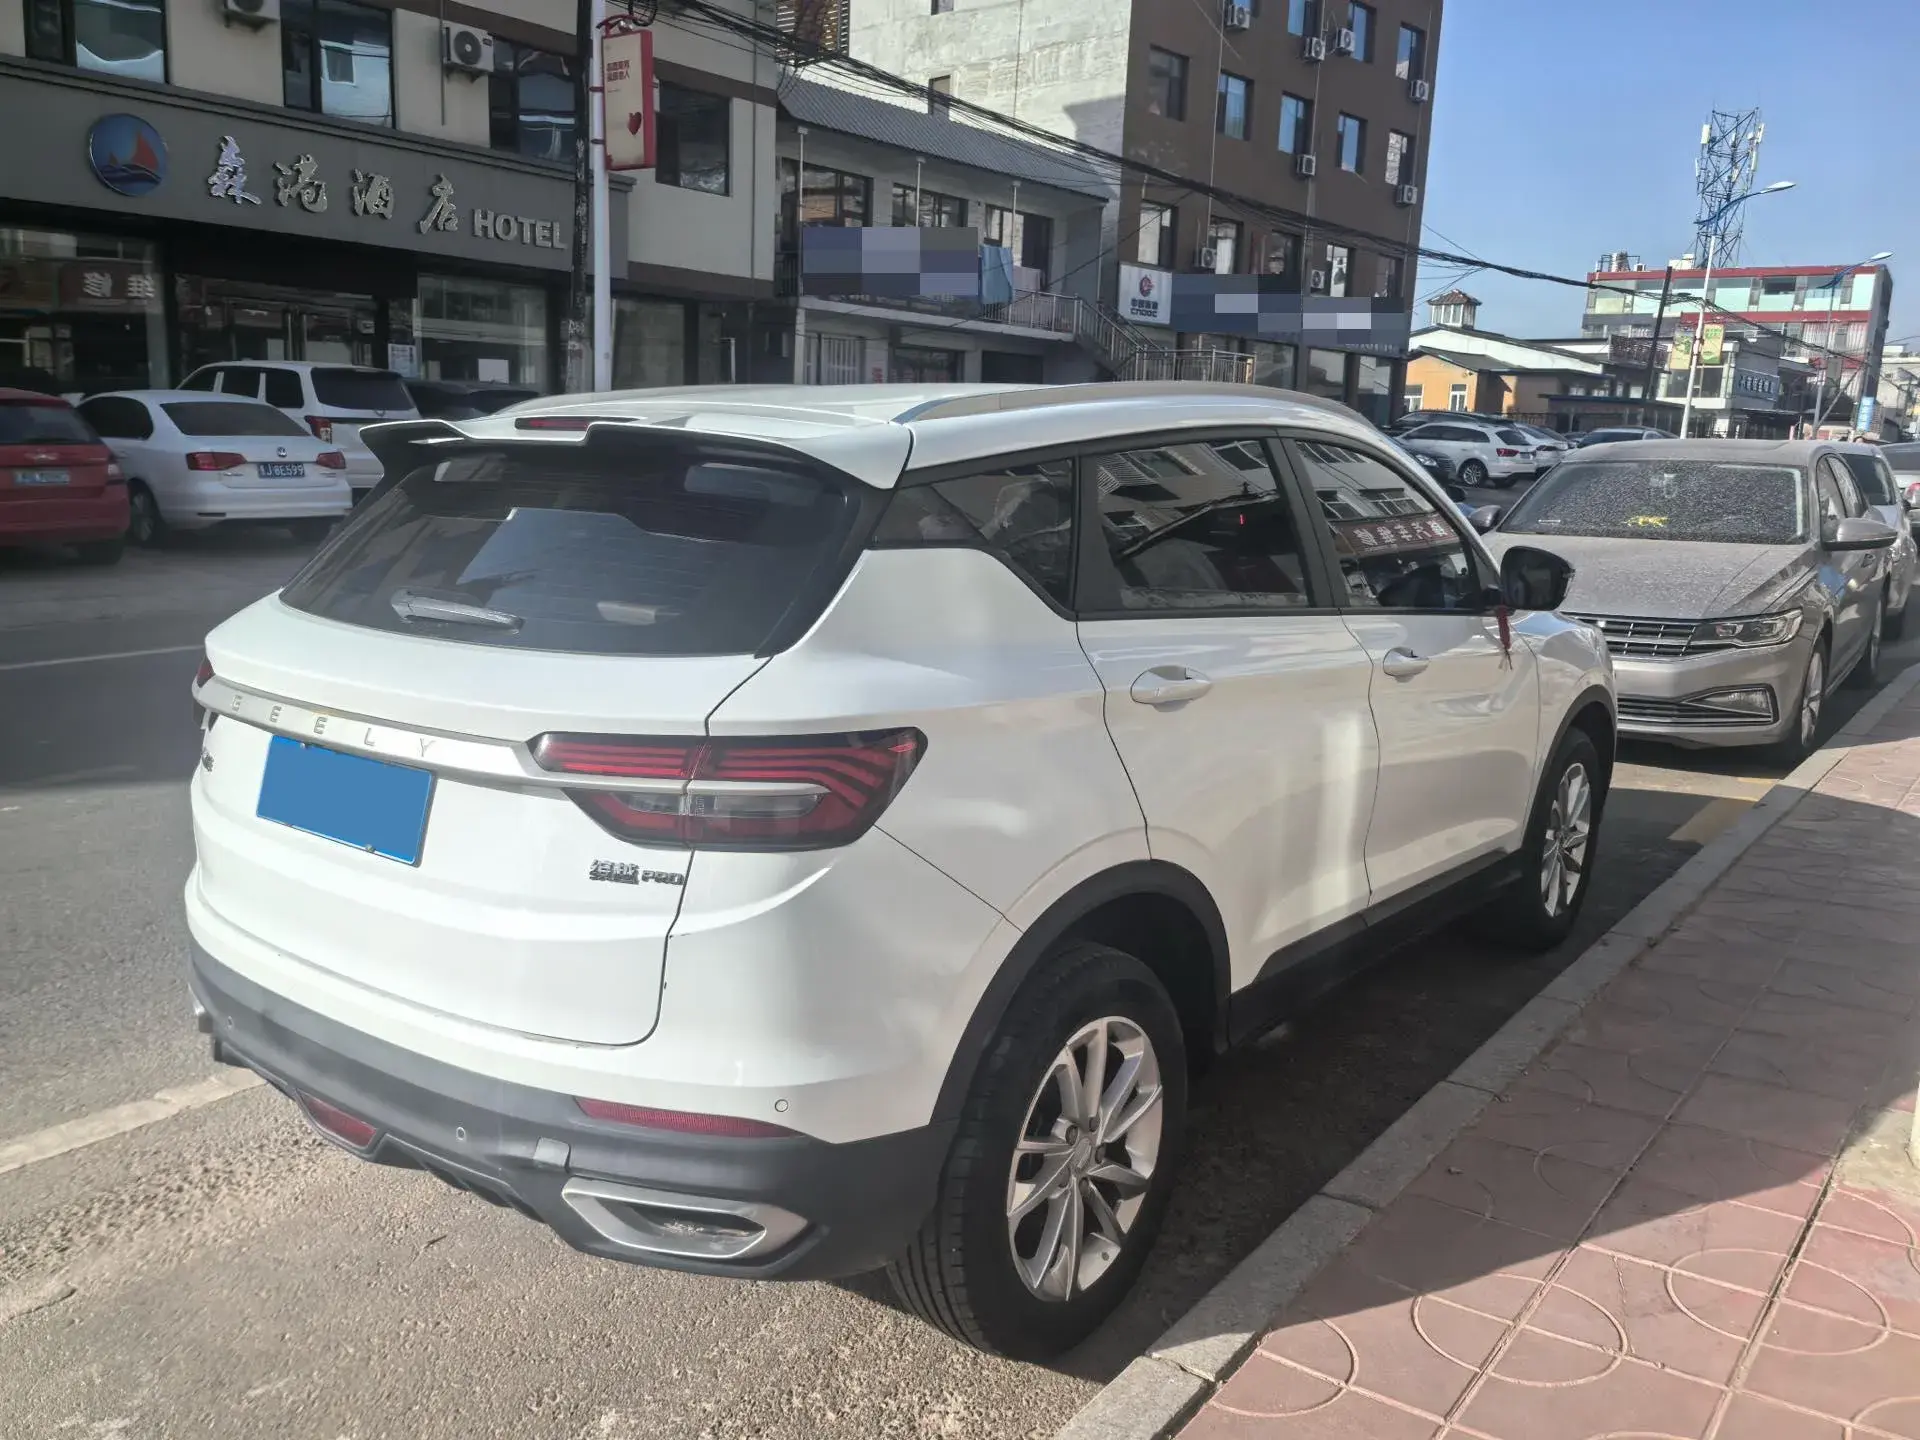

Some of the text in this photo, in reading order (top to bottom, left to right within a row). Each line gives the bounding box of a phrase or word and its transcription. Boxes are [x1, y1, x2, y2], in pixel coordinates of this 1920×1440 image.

[472, 208, 568, 250] HOTEL
[231, 694, 436, 758] GEELY
[642, 869, 685, 886] PRO
